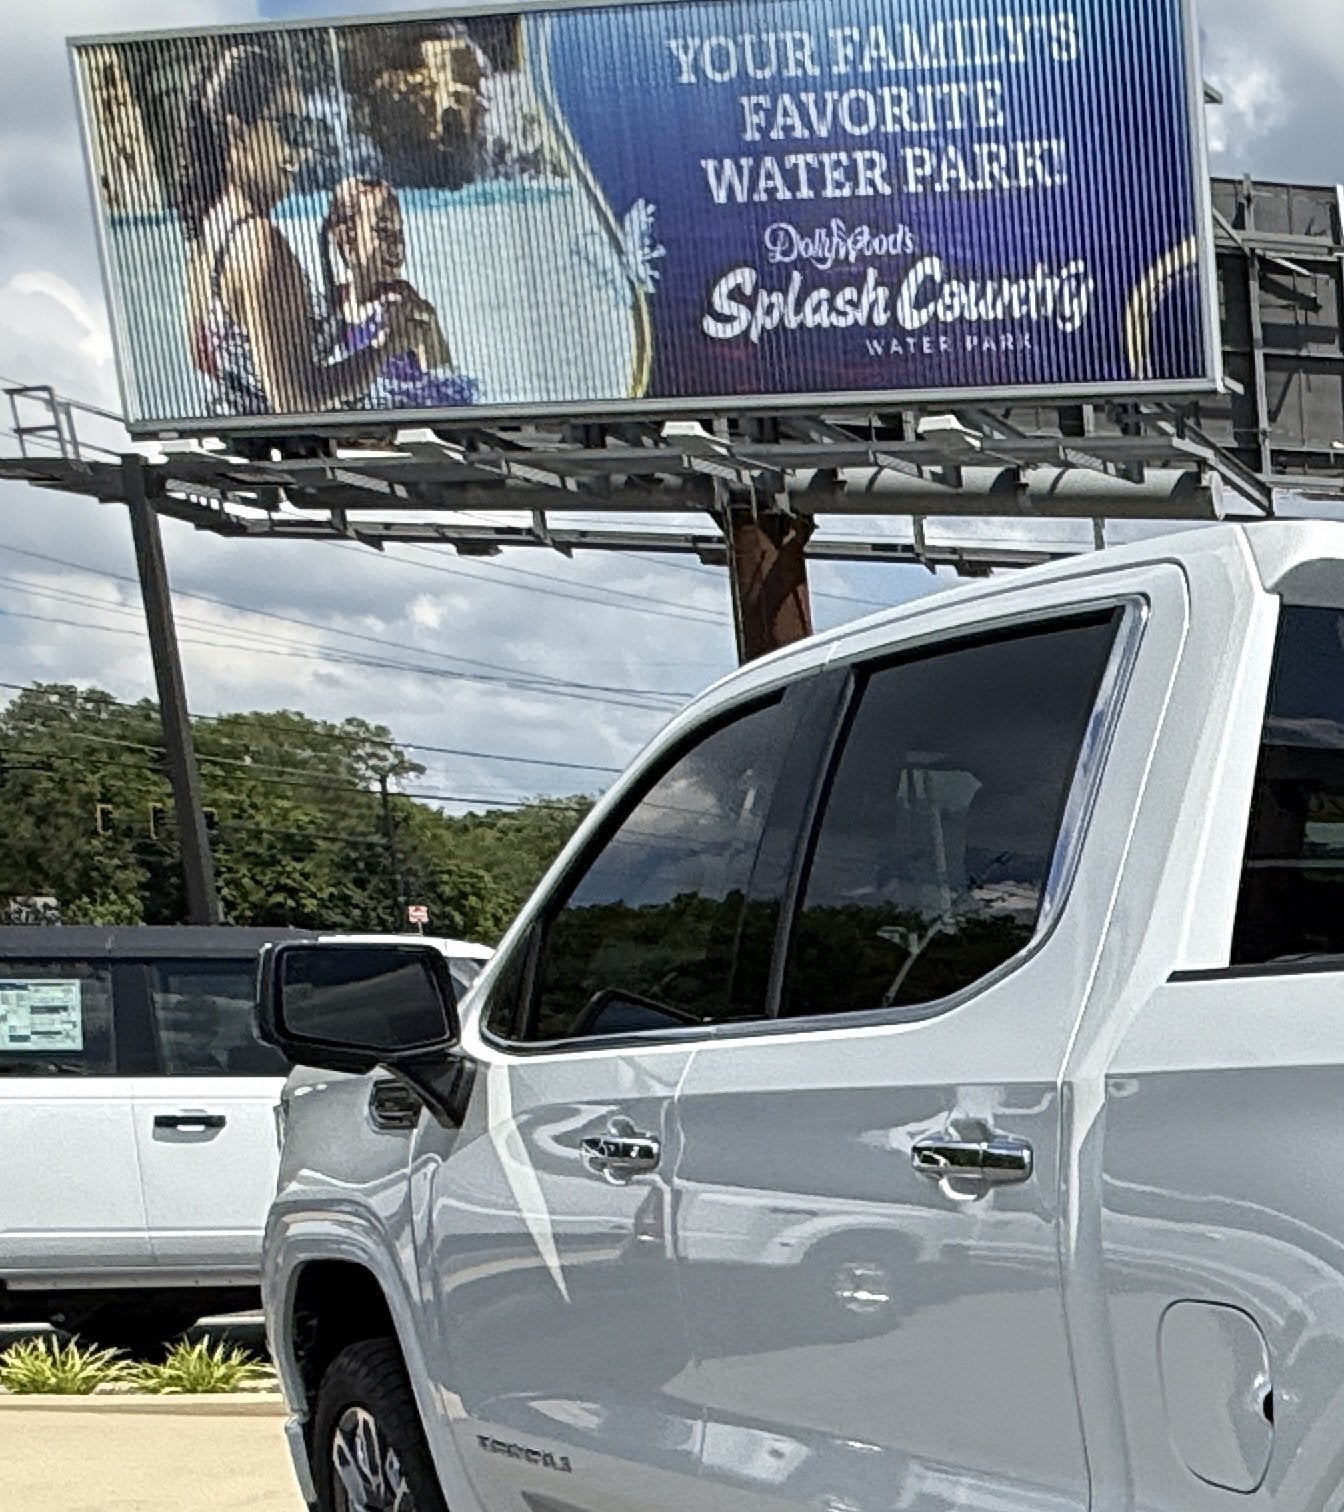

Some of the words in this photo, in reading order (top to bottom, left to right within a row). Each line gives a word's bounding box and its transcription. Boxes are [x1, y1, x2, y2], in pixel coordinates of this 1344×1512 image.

[665, 30, 820, 84] YOUR
[828, 12, 1078, 74] FAMILY'S
[740, 80, 1004, 141] FAVORITE
[701, 150, 892, 204] WATER
[902, 138, 1068, 194] PARK!
[702, 266, 891, 344] Splash
[897, 255, 1094, 333] Country
[866, 335, 949, 355] WATER
[965, 332, 1032, 352] PARK
